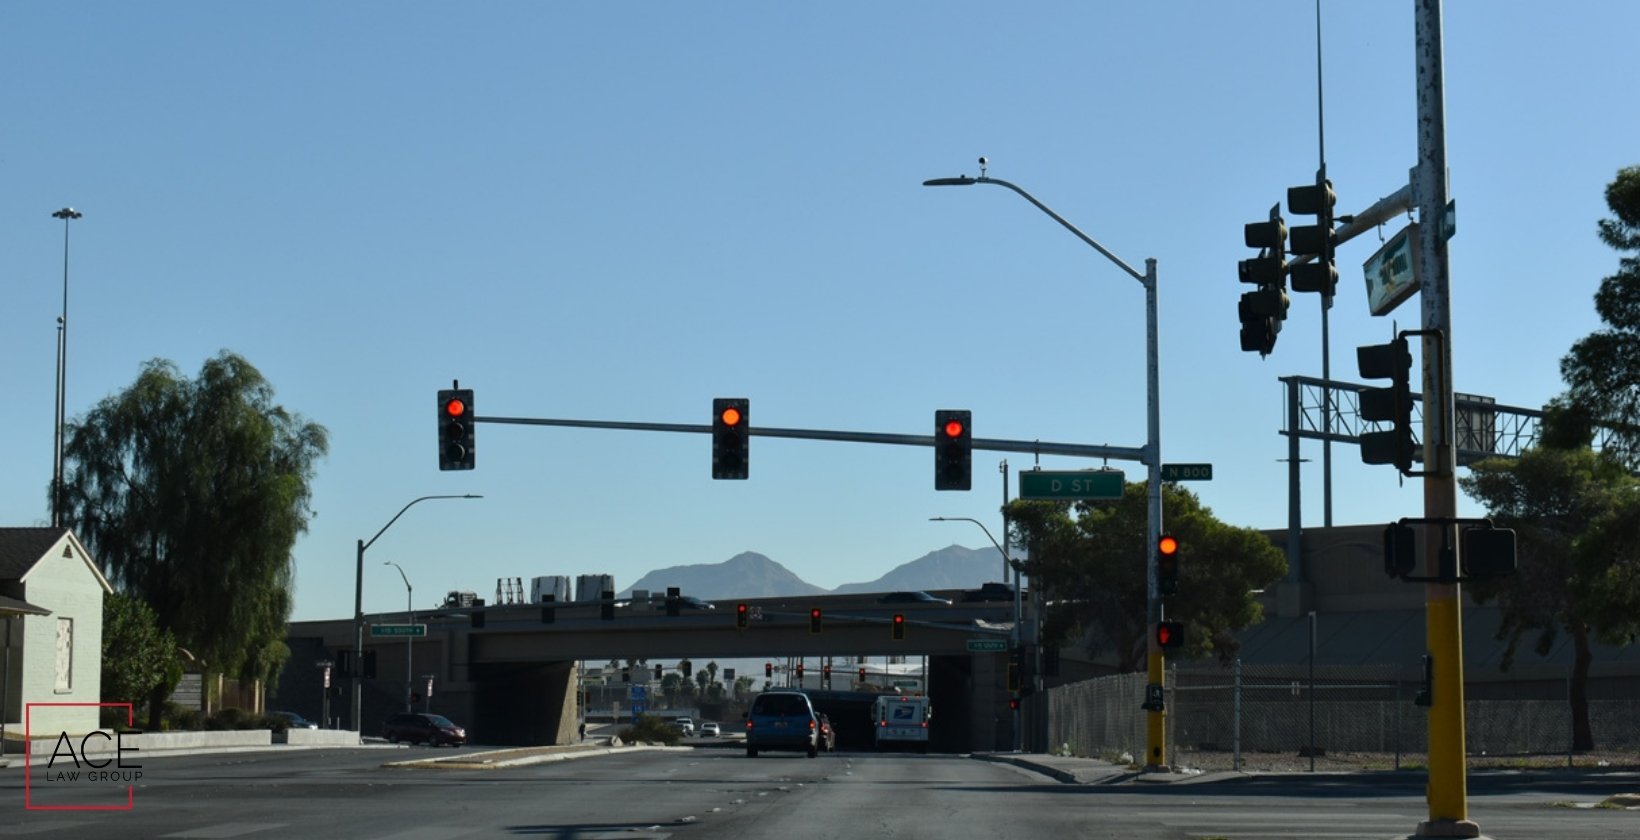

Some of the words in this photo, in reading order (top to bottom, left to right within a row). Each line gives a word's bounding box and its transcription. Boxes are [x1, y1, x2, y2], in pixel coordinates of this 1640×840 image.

[1169, 468, 1178, 477] N
[1183, 467, 1209, 477] 800
[1051, 479, 1062, 492] D
[1071, 479, 1093, 492] ST
